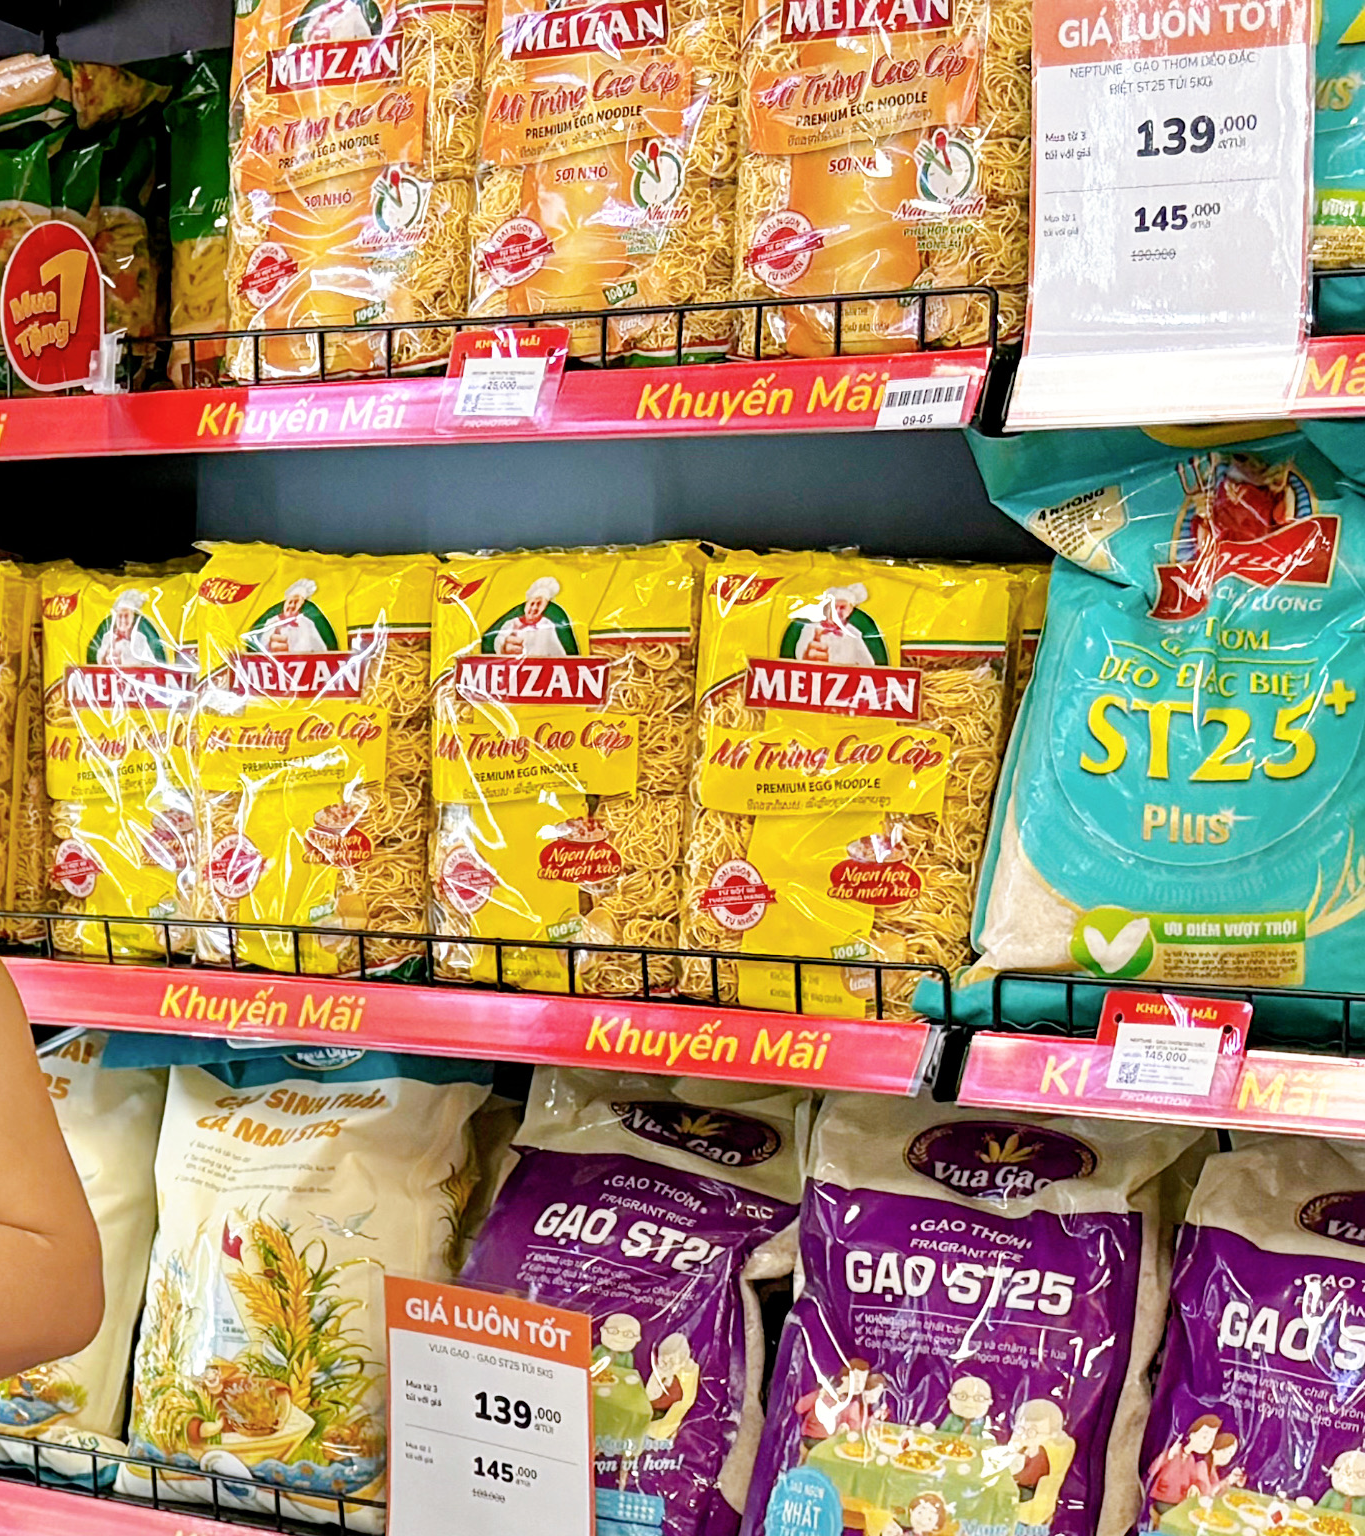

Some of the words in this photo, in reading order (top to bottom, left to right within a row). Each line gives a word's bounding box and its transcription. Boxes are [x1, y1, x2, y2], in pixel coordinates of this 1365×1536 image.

[509, 4, 666, 56] MEIZAN
[269, 38, 401, 90] MEIZAN
[525, 121, 572, 141] PREMIUM
[573, 114, 594, 130] EGG
[596, 105, 644, 125] NOODLE
[1135, 113, 1257, 158] 139,000
[1134, 202, 1221, 234] 145,000
[9, 284, 61, 323] Mua
[15, 315, 69, 360] Tặng
[196, 390, 329, 442] Khuyến
[334, 389, 406, 432] Mãi
[902, 414, 934, 427] 09-05
[459, 664, 605, 700] MEIZAN
[750, 667, 916, 715] MEIZAN
[710, 737, 750, 768] Mì
[754, 736, 830, 778] Trứng
[834, 733, 883, 767] Cao
[886, 734, 943, 773] Cấp
[755, 782, 807, 795] PREMIUM
[808, 779, 832, 793] EGG
[833, 777, 881, 792] NOODLE
[1142, 802, 1231, 845] Plus
[549, 846, 587, 870] Ngon
[840, 866, 881, 887] Ngon
[159, 981, 288, 1028] Khuyến
[298, 995, 364, 1033] Mãi
[584, 1013, 733, 1065] Khuyến
[751, 1023, 831, 1072] Mãi
[1144, 1050, 1188, 1063] 145,000
[600, 1192, 665, 1220] FRAGRANT
[666, 1212, 698, 1228] RICE
[611, 1174, 651, 1190] GẠO
[653, 1180, 701, 1211] THƠM
[910, 1238, 987, 1260] FRAGRANT
[920, 1219, 967, 1234] GẠO
[970, 1224, 1025, 1250] THƠM
[405, 1295, 448, 1326] GIÁ
[454, 1304, 520, 1342] LUÔN
[525, 1317, 572, 1352] TỐT
[474, 1391, 562, 1430] 139,000
[473, 1456, 538, 1484] 145,000
[783, 1500, 822, 1530] NHẤT
